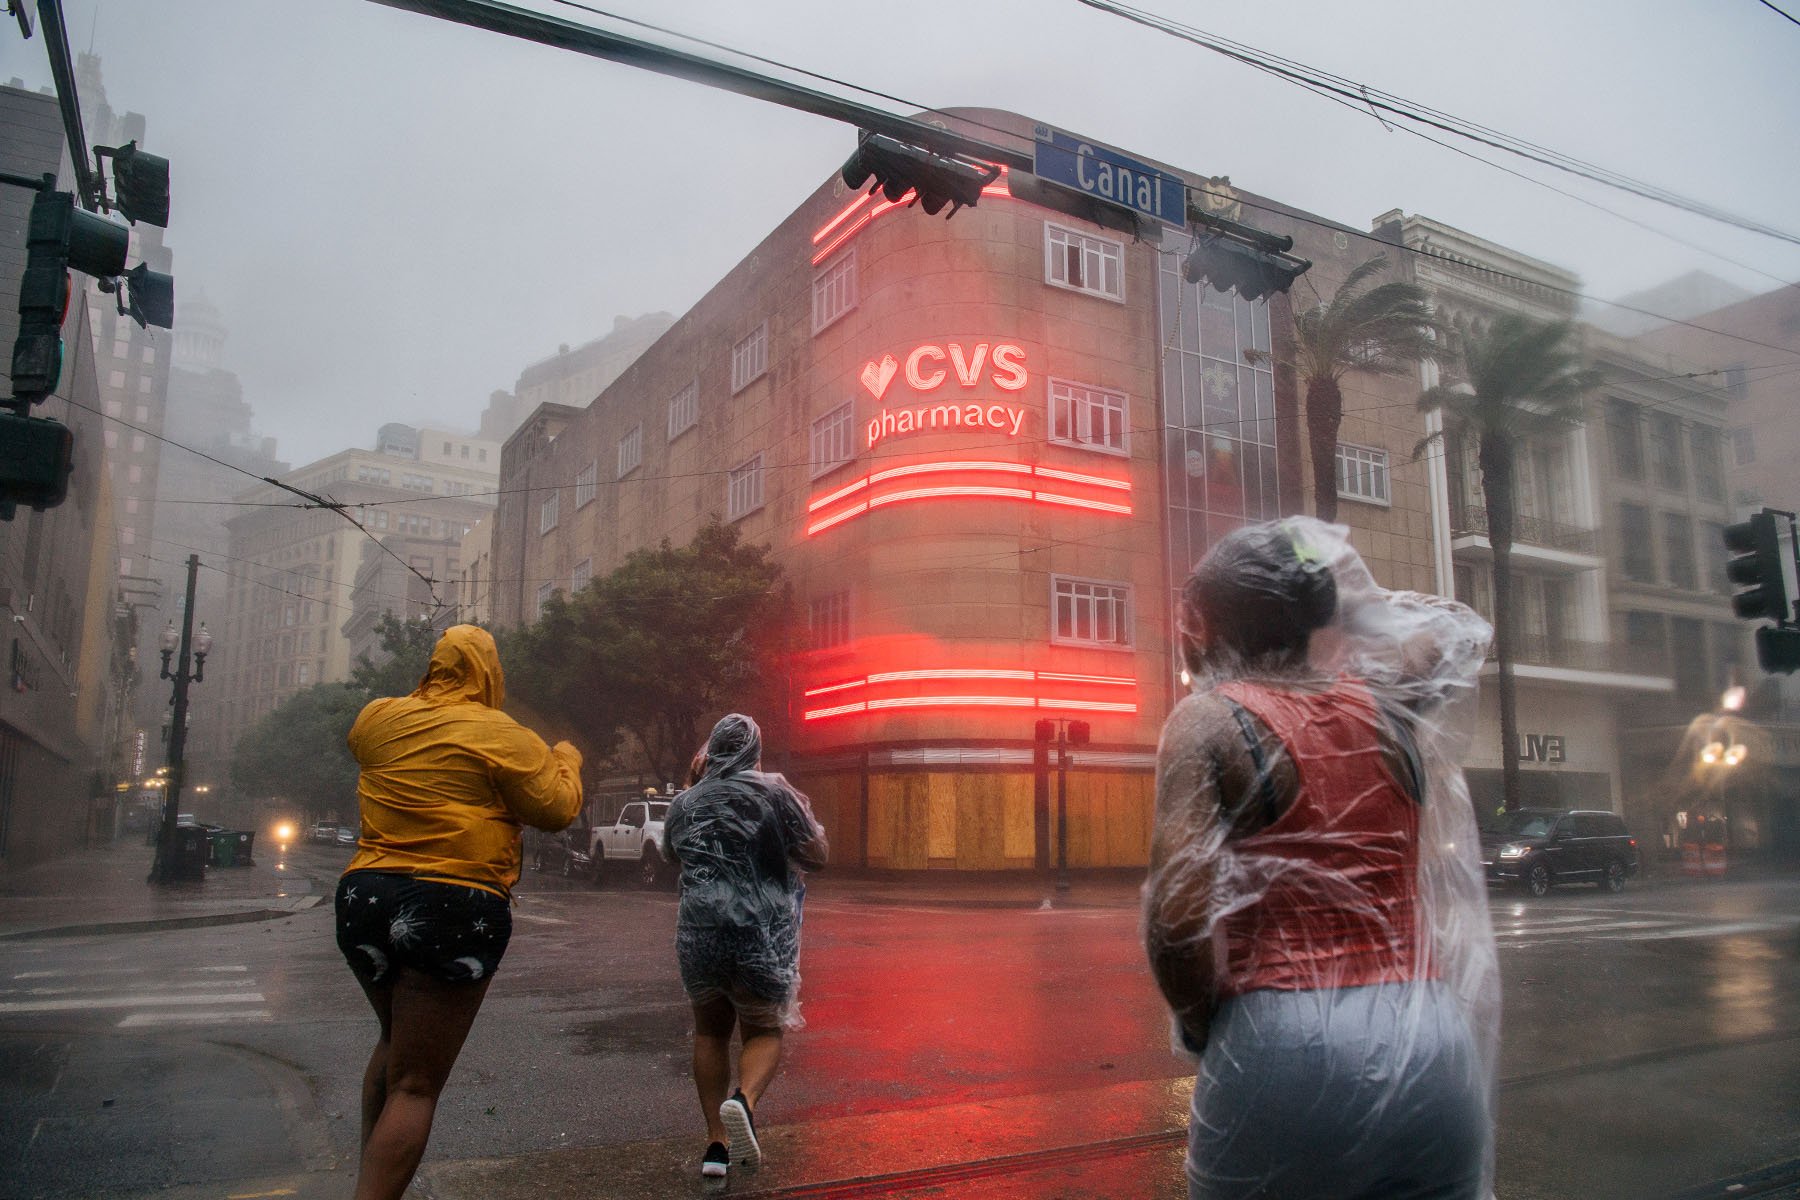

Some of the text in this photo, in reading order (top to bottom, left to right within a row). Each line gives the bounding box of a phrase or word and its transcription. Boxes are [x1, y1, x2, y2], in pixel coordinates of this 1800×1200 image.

[1077, 144, 1162, 216] Canal
[905, 343, 1028, 390] CVS
[868, 404, 1025, 448] pharmacy
